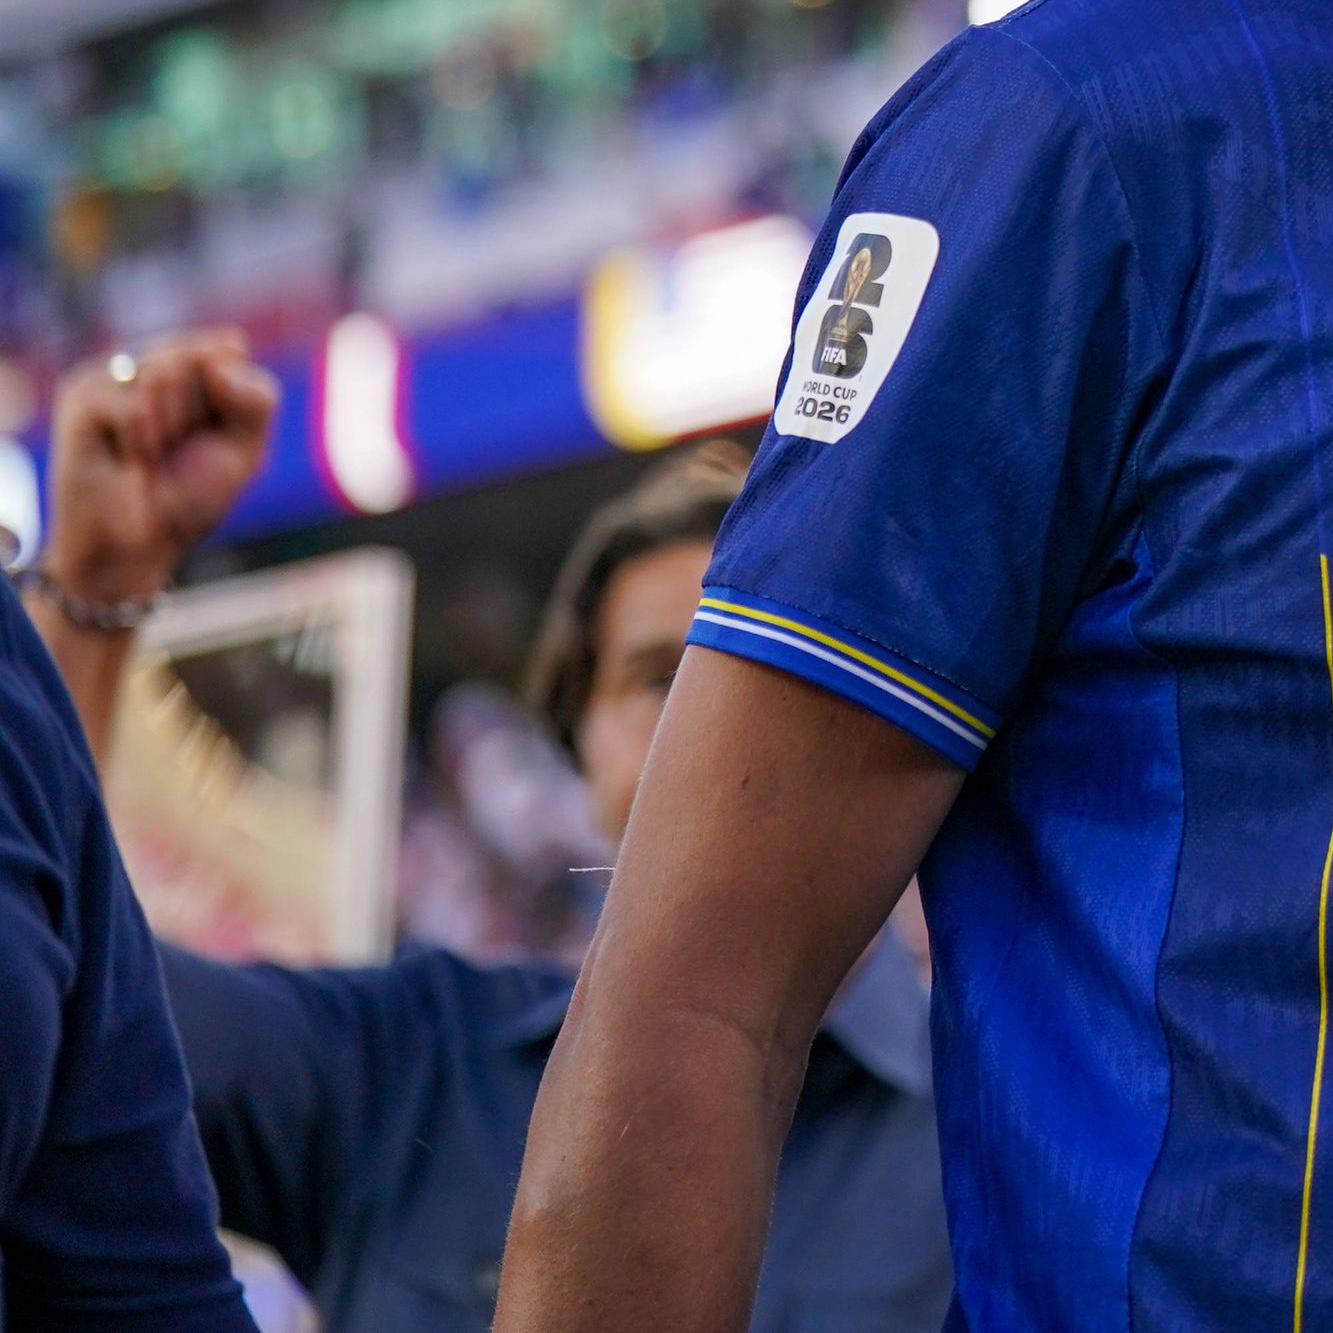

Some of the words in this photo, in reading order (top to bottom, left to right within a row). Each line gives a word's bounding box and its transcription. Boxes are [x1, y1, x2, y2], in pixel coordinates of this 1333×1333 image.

[821, 346, 847, 366] FIFA
[833, 386, 858, 401] CUP
[794, 396, 852, 425] 2026
